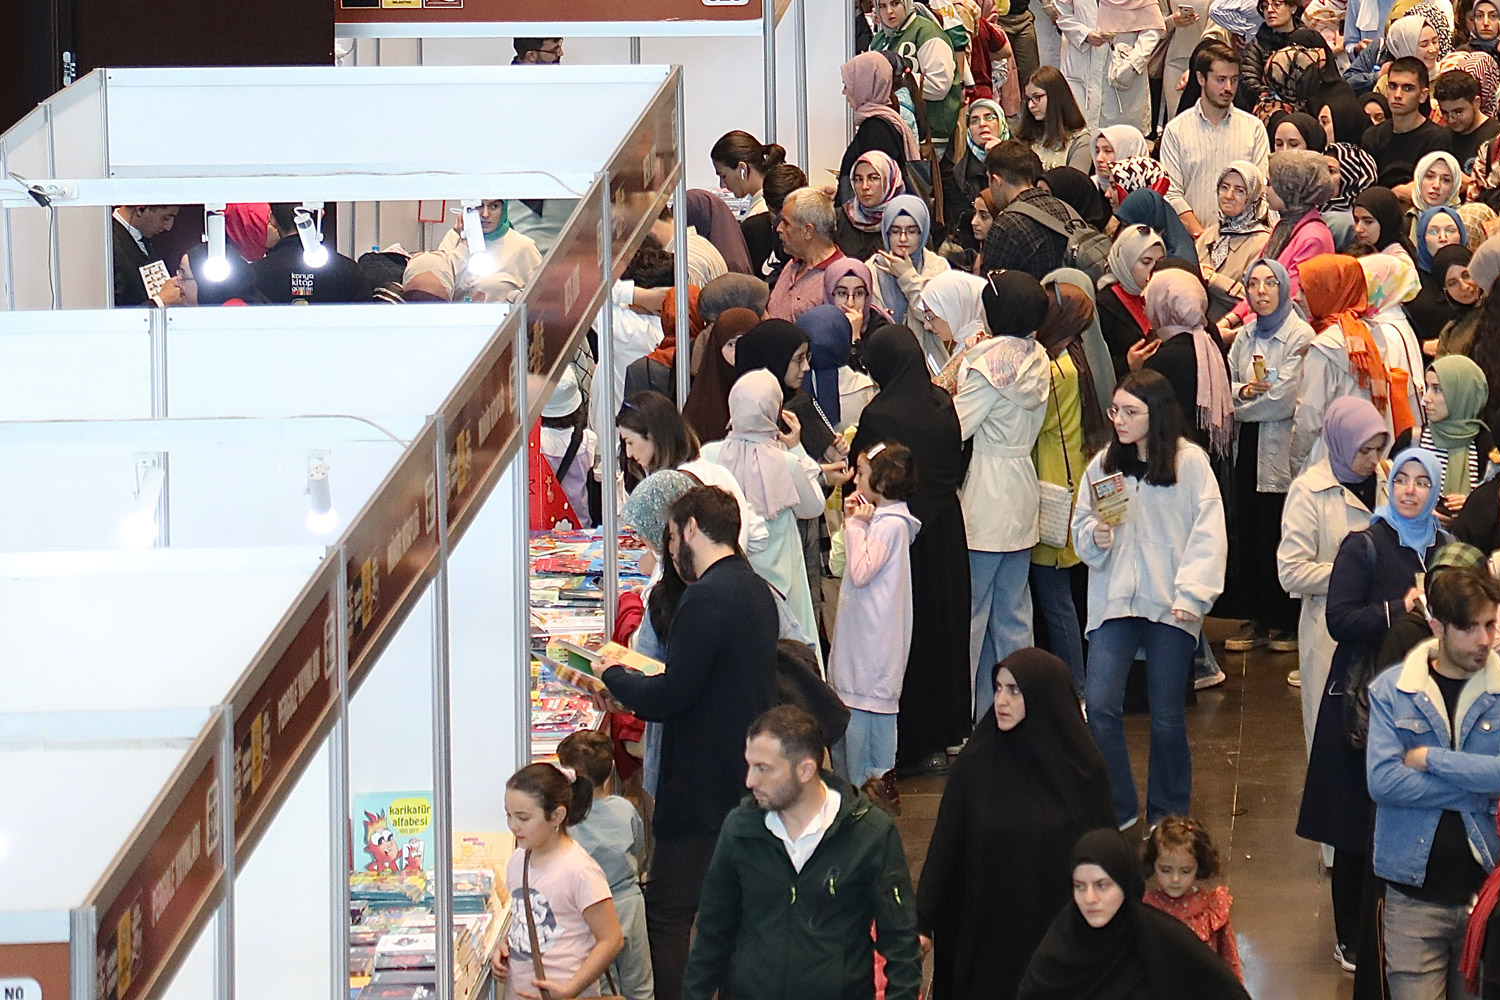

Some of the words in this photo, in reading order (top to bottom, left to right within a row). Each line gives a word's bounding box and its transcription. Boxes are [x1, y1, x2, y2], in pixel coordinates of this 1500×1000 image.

[291, 279, 314, 287] kitap
[389, 805, 431, 816] karikatür
[392, 817, 428, 827] alfabesi
